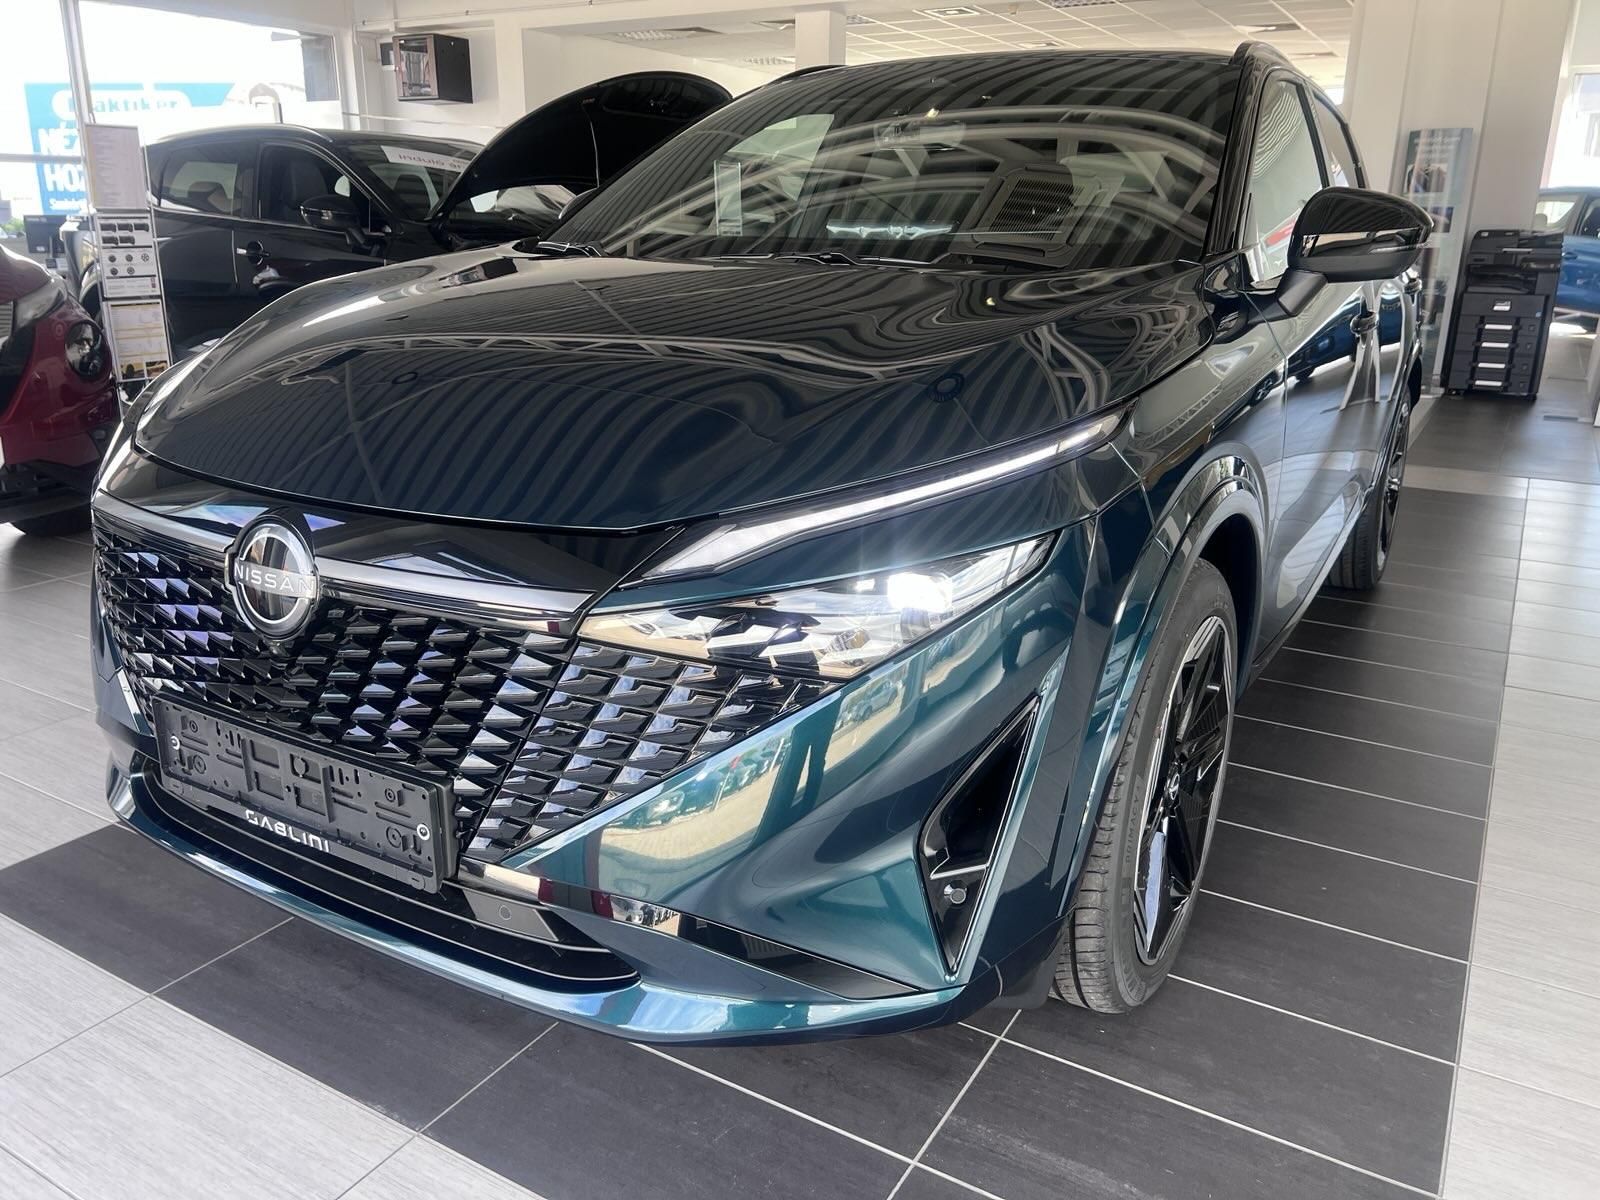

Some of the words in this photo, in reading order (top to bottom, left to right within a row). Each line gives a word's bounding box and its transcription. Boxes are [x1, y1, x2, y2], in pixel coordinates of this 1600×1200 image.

[69, 96, 178, 112] aktiker
[234, 562, 315, 597] NISSAN
[245, 809, 330, 853] GABLINI
